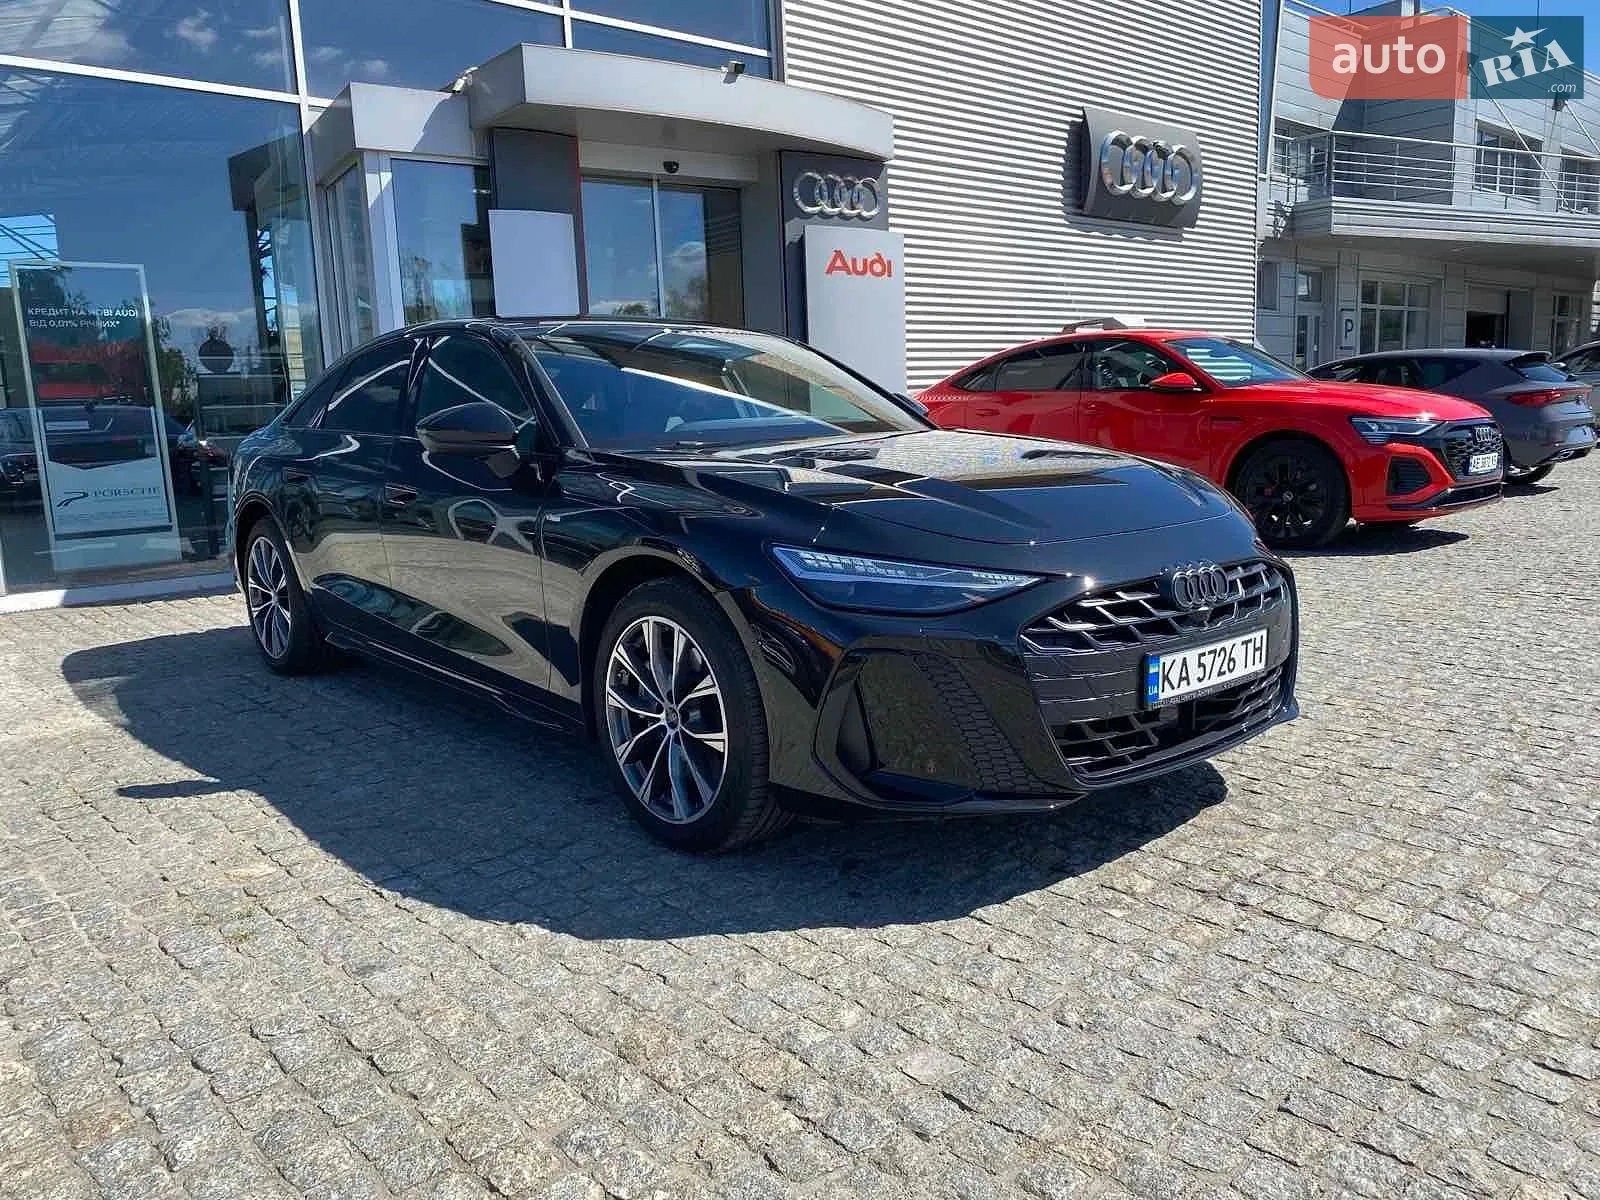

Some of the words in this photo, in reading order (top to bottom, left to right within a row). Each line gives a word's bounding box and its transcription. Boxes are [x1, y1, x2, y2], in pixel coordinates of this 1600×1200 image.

[825, 249, 892, 278] Audi
[28, 307, 69, 317] КРЕДИТ
[114, 308, 138, 318] AUDI
[29, 319, 46, 328] ВІД
[1344, 319, 1354, 340] P
[1161, 657, 1190, 693] KA
[1197, 643, 1236, 683] 5726
[1242, 634, 1264, 669] TH
[1148, 685, 1158, 696] UA
